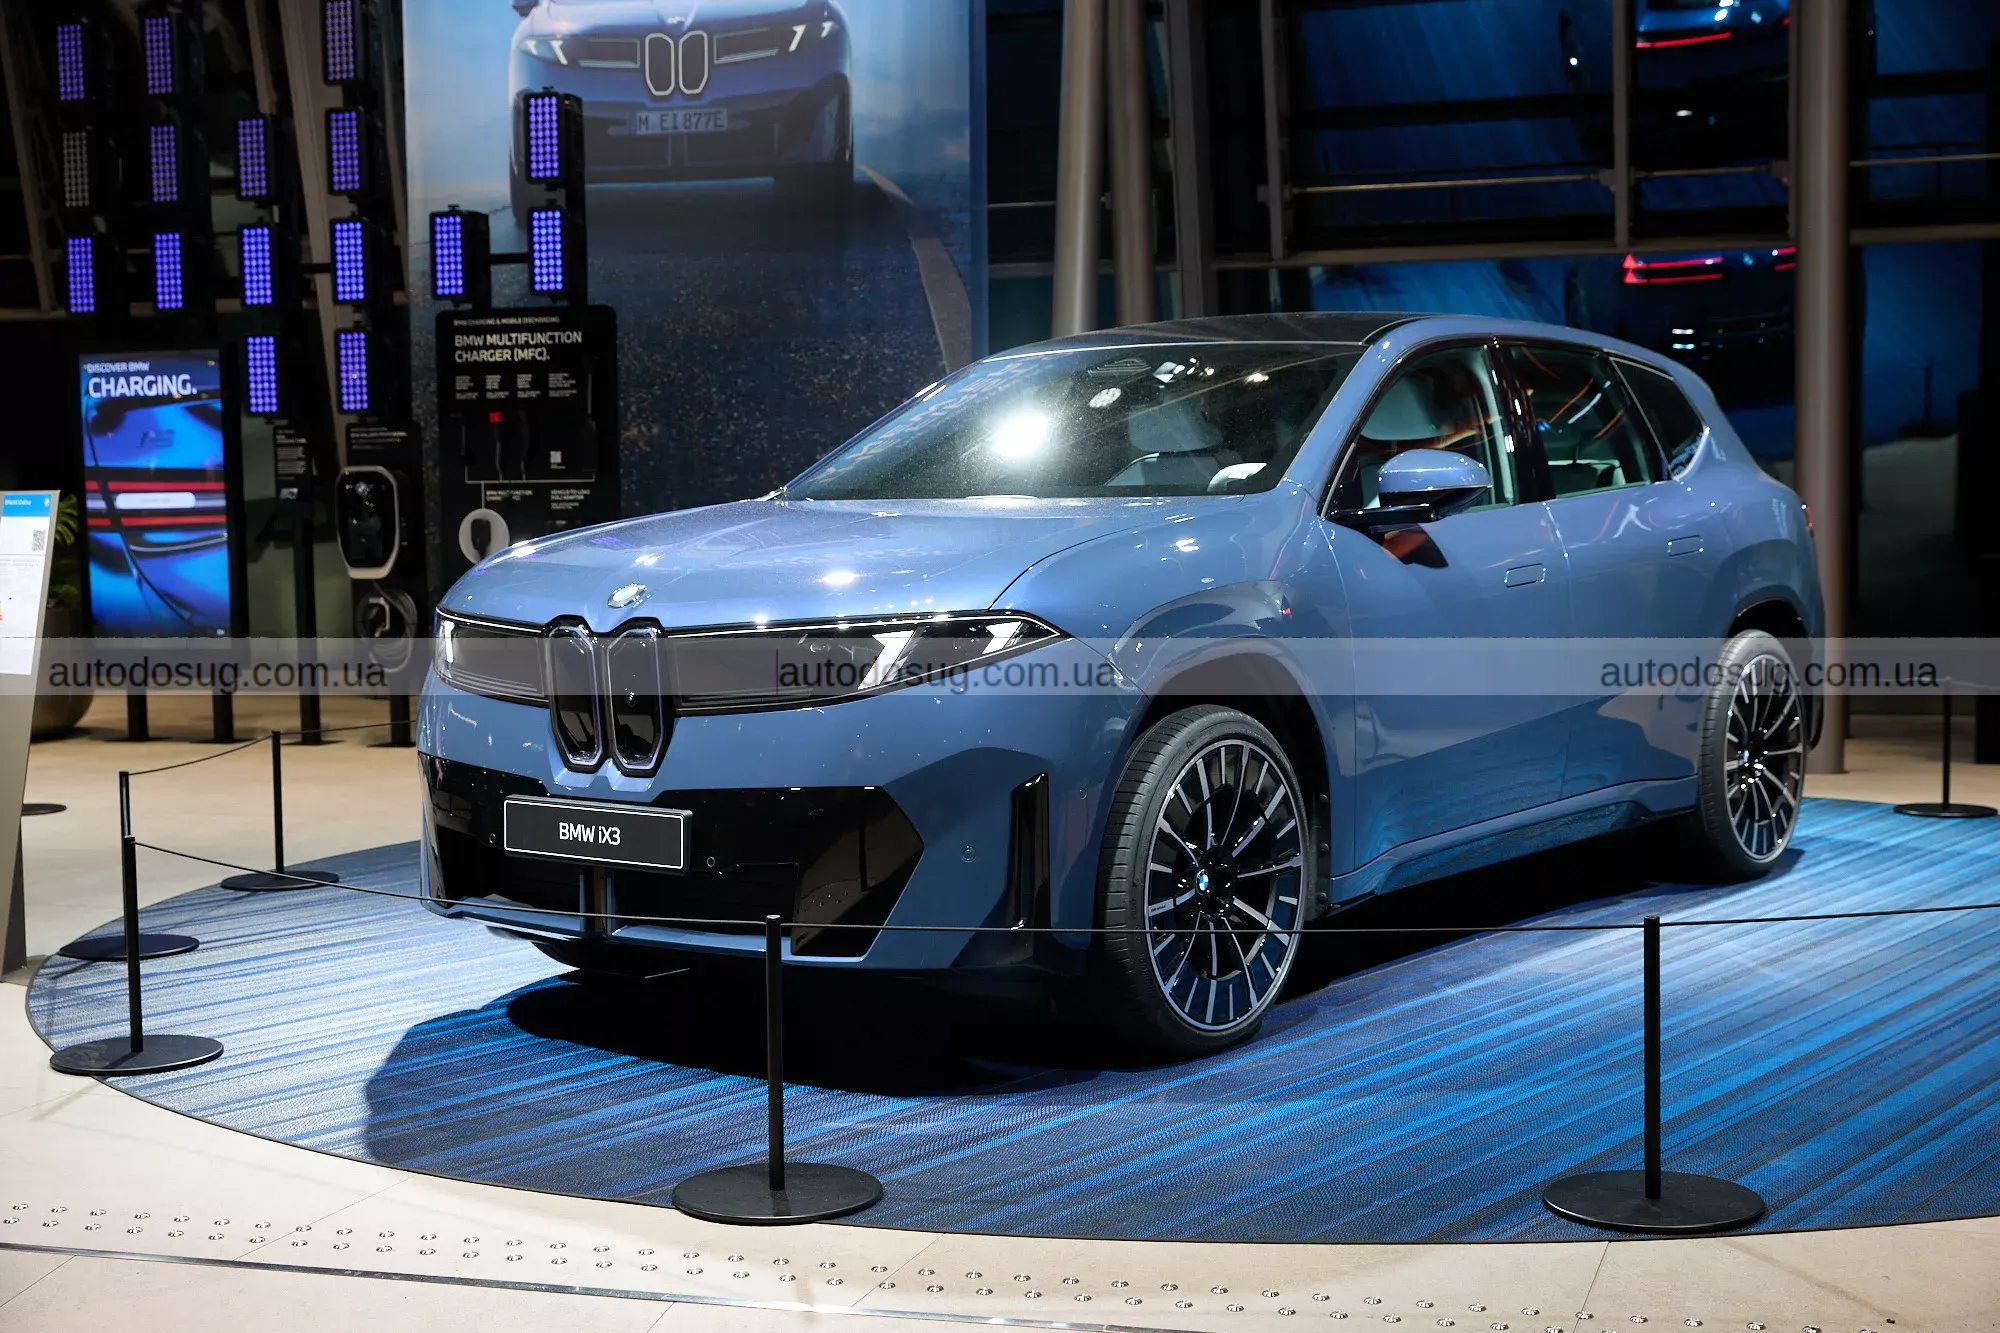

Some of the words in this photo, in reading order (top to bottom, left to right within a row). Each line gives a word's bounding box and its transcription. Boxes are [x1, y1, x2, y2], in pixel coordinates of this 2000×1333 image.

[638, 114, 650, 132] M
[454, 334, 484, 347] BMW
[486, 331, 582, 346] MULTIFUNCTION
[454, 349, 511, 363] CHARGER
[513, 347, 550, 362] (MFC).
[86, 362, 128, 374] DISCOVER
[129, 360, 150, 372] BMW
[88, 374, 198, 398] CHARGING.
[559, 822, 595, 842] BMW
[598, 825, 621, 846] iX3
